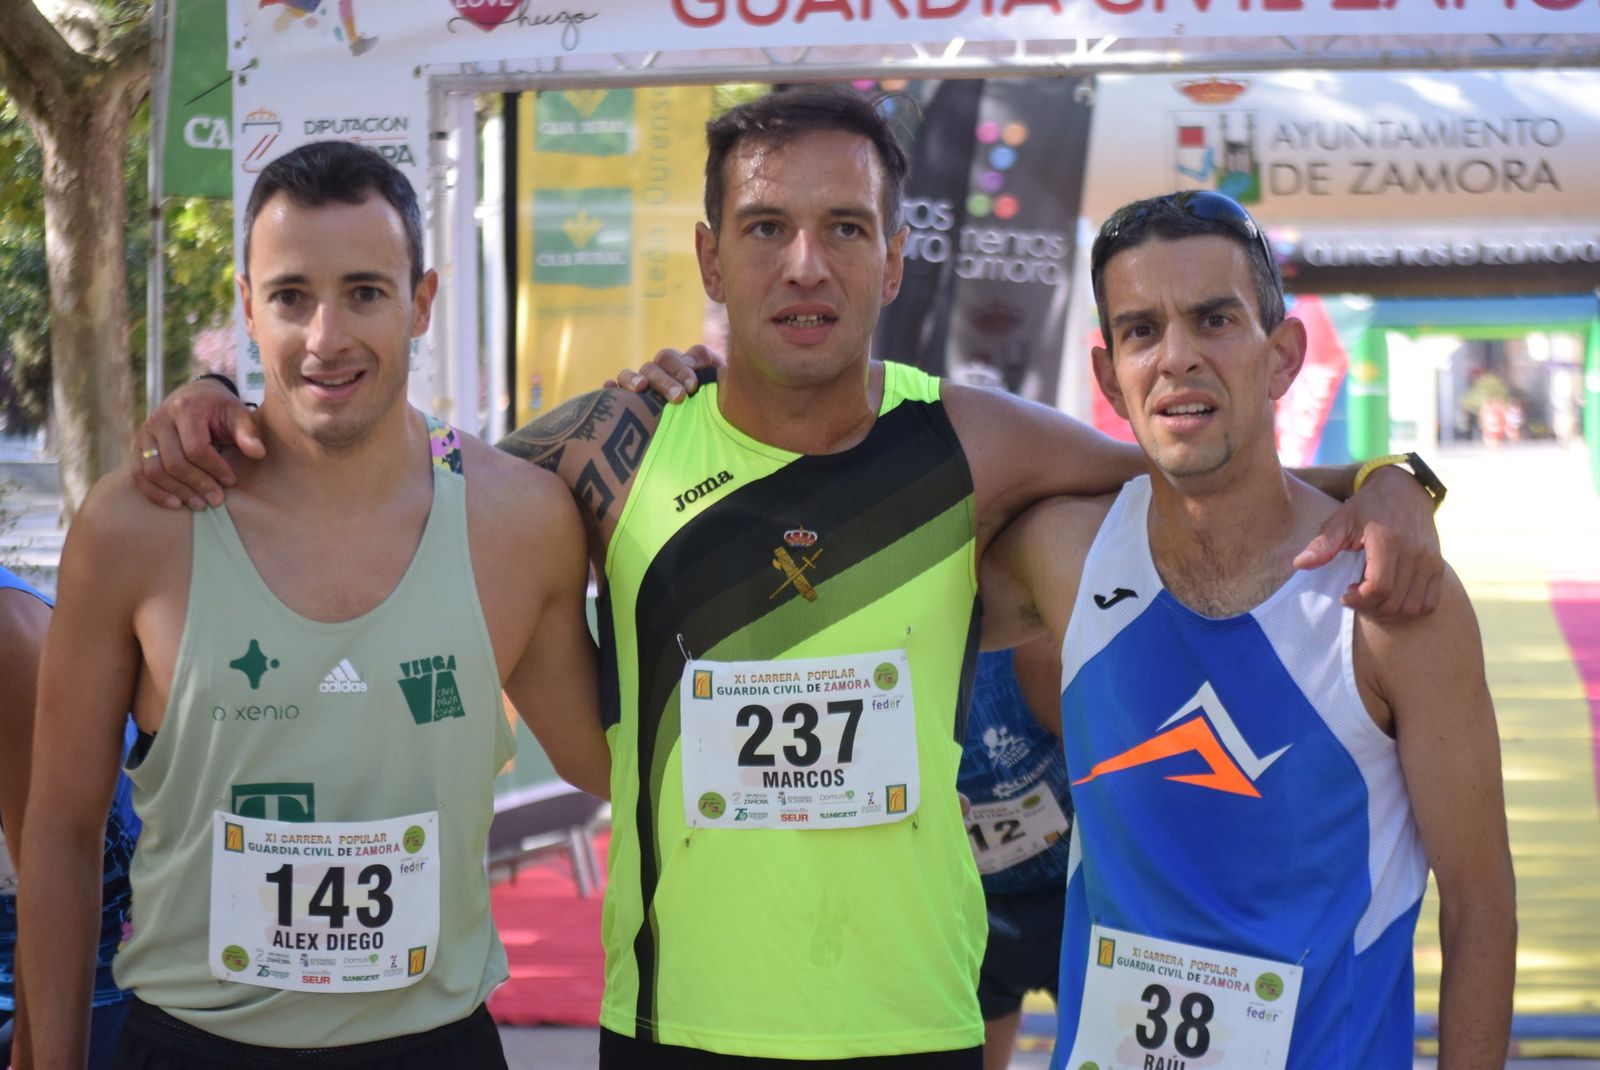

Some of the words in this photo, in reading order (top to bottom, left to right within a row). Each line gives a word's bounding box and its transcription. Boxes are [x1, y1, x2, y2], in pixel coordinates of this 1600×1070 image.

[1269, 161, 1332, 195] DE
[1348, 158, 1563, 196] ZAMORA
[735, 675, 747, 684] XI
[750, 672, 800, 683] CARRERA
[807, 669, 855, 681] POPULAR
[319, 680, 368, 693] adidas
[717, 685, 770, 696] GUARDIA
[773, 685, 803, 694] CIVIL
[806, 683, 821, 693] DE
[824, 679, 870, 692] ZAMORA
[235, 704, 299, 721] xenio
[872, 699, 901, 711] feder
[736, 699, 863, 767] 237
[763, 769, 845, 788] MARCOS
[780, 813, 808, 822] SEUR
[265, 833, 277, 842] XI
[281, 834, 331, 845] CARRERA
[339, 833, 387, 844] POPULAR
[248, 842, 300, 856] GUARDIA
[303, 847, 334, 857] CIVIL
[337, 848, 352, 857] DE
[355, 842, 401, 856] ZAMORA
[400, 861, 425, 874] feder
[266, 864, 394, 928] 143
[272, 930, 319, 950] ALEX
[327, 932, 384, 951] DIEGO
[1132, 947, 1142, 958] XI
[1143, 950, 1184, 967] CARRERA
[1190, 960, 1238, 977] POPULAR
[302, 975, 331, 984] SEUR
[1117, 957, 1156, 975] GUARDIA
[1158, 966, 1184, 980] CIVIL
[1187, 972, 1200, 983] DE
[1202, 975, 1250, 993] ZAMORA
[1135, 984, 1214, 1059] 38
[1246, 1006, 1279, 1023] feder
